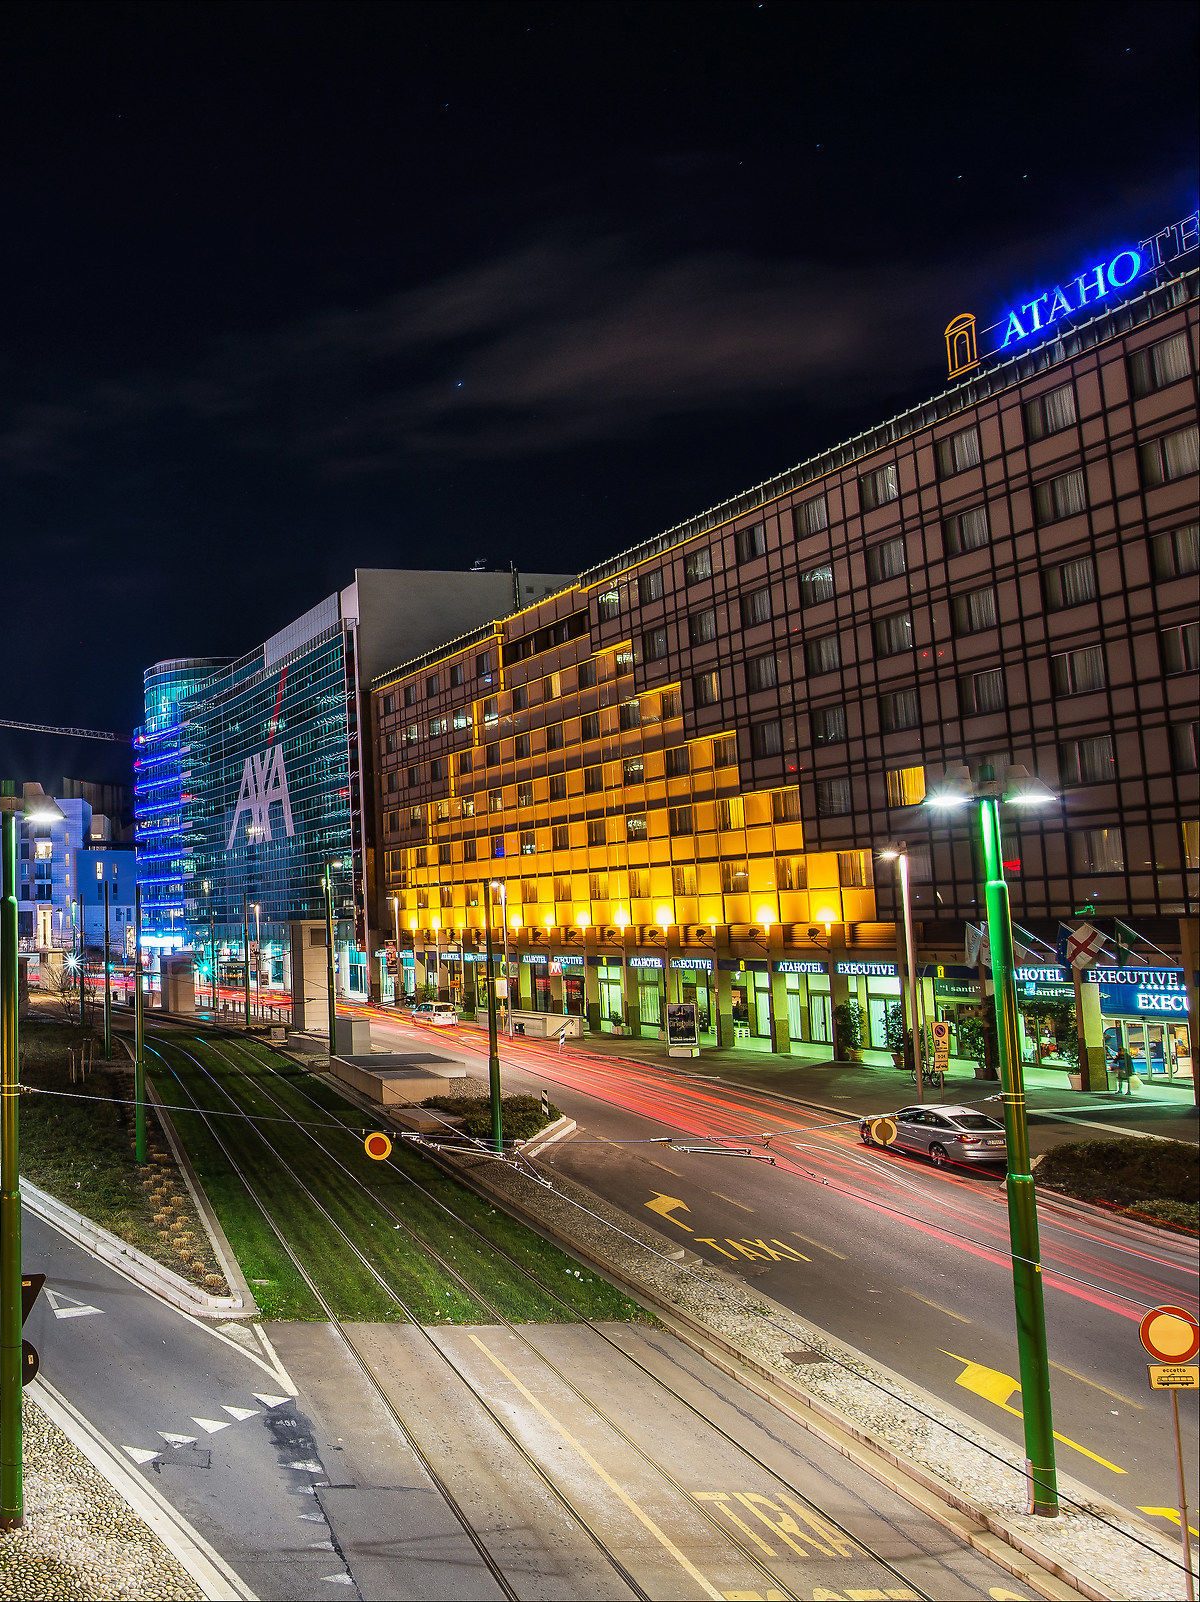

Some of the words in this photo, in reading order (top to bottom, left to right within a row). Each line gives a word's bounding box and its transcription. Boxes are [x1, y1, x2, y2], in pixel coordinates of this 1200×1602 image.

[227, 744, 295, 850] AXA
[522, 954, 548, 964] ATAHOTEL
[553, 955, 584, 965] EXECUTIVE
[630, 957, 663, 968] ATAHOTEL
[671, 959, 712, 969] EXECUTIVE
[778, 961, 824, 973] ATAHOTEL
[837, 963, 895, 976] EXECUTIVE
[1087, 970, 1179, 985] EXECUTIVE
[693, 1238, 814, 1263] TAXI
